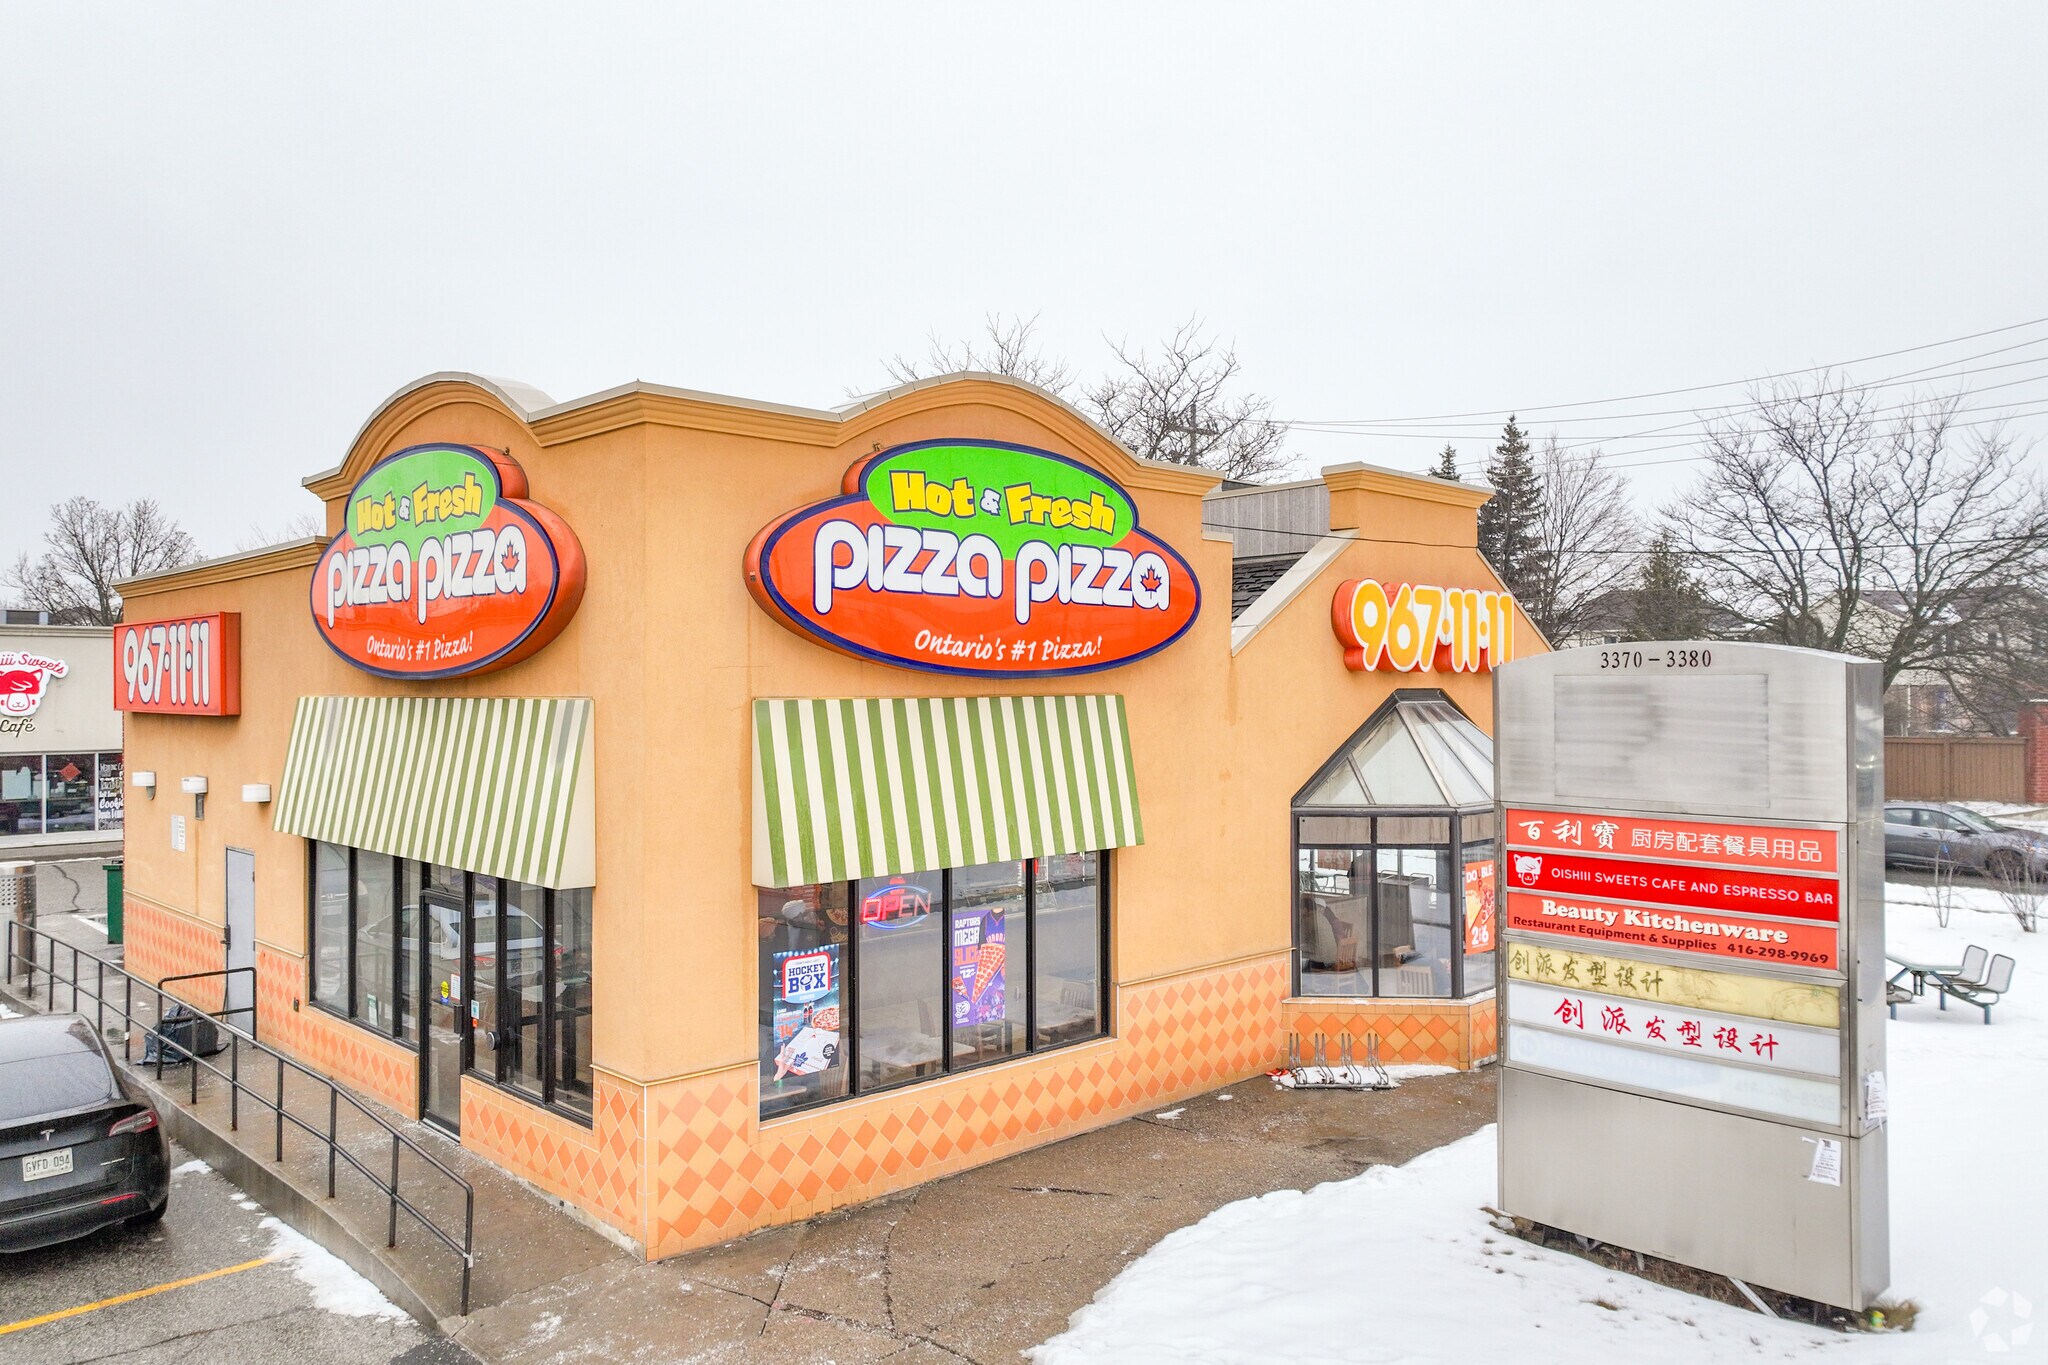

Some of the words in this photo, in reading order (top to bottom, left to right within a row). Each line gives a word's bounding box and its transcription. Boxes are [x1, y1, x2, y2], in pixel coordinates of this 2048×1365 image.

[356, 490, 397, 536] Hot
[398, 496, 411, 522] &
[412, 471, 484, 527] Fresh
[889, 469, 976, 518] Hot
[980, 489, 1002, 517] &
[1003, 481, 1116, 536] Fresh
[366, 634, 414, 660] Ontario's
[415, 640, 431, 661] #1
[433, 629, 474, 660] Pizza!
[915, 628, 1005, 661] Ontario's
[1010, 639, 1037, 662] #1
[1042, 634, 1102, 661] Pizza!
[1601, 651, 1643, 669] 3370
[1666, 650, 1712, 668] 3380
[18, 653, 65, 674] Sweets
[0, 718, 36, 738] Café
[1551, 868, 1591, 882] OISHIII
[1595, 872, 1648, 887] SWEETS
[1651, 878, 1686, 891] CAFE
[1690, 882, 1719, 894] AND
[1723, 885, 1800, 901] ESPRESSO
[1805, 893, 1833, 905] BAR
[862, 894, 931, 922] OPEN
[1541, 899, 1619, 926] Beauty
[1623, 908, 1788, 944] Kitchenware
[955, 927, 980, 947] MEGA
[1513, 916, 1576, 932] Restaurant
[1579, 925, 1645, 942] Equipment
[1649, 934, 1657, 943] &
[1662, 935, 1717, 950] Supplies
[1727, 943, 1829, 964] 416-298-9969
[788, 963, 825, 976] HOCKEY
[788, 973, 826, 993] BOX
